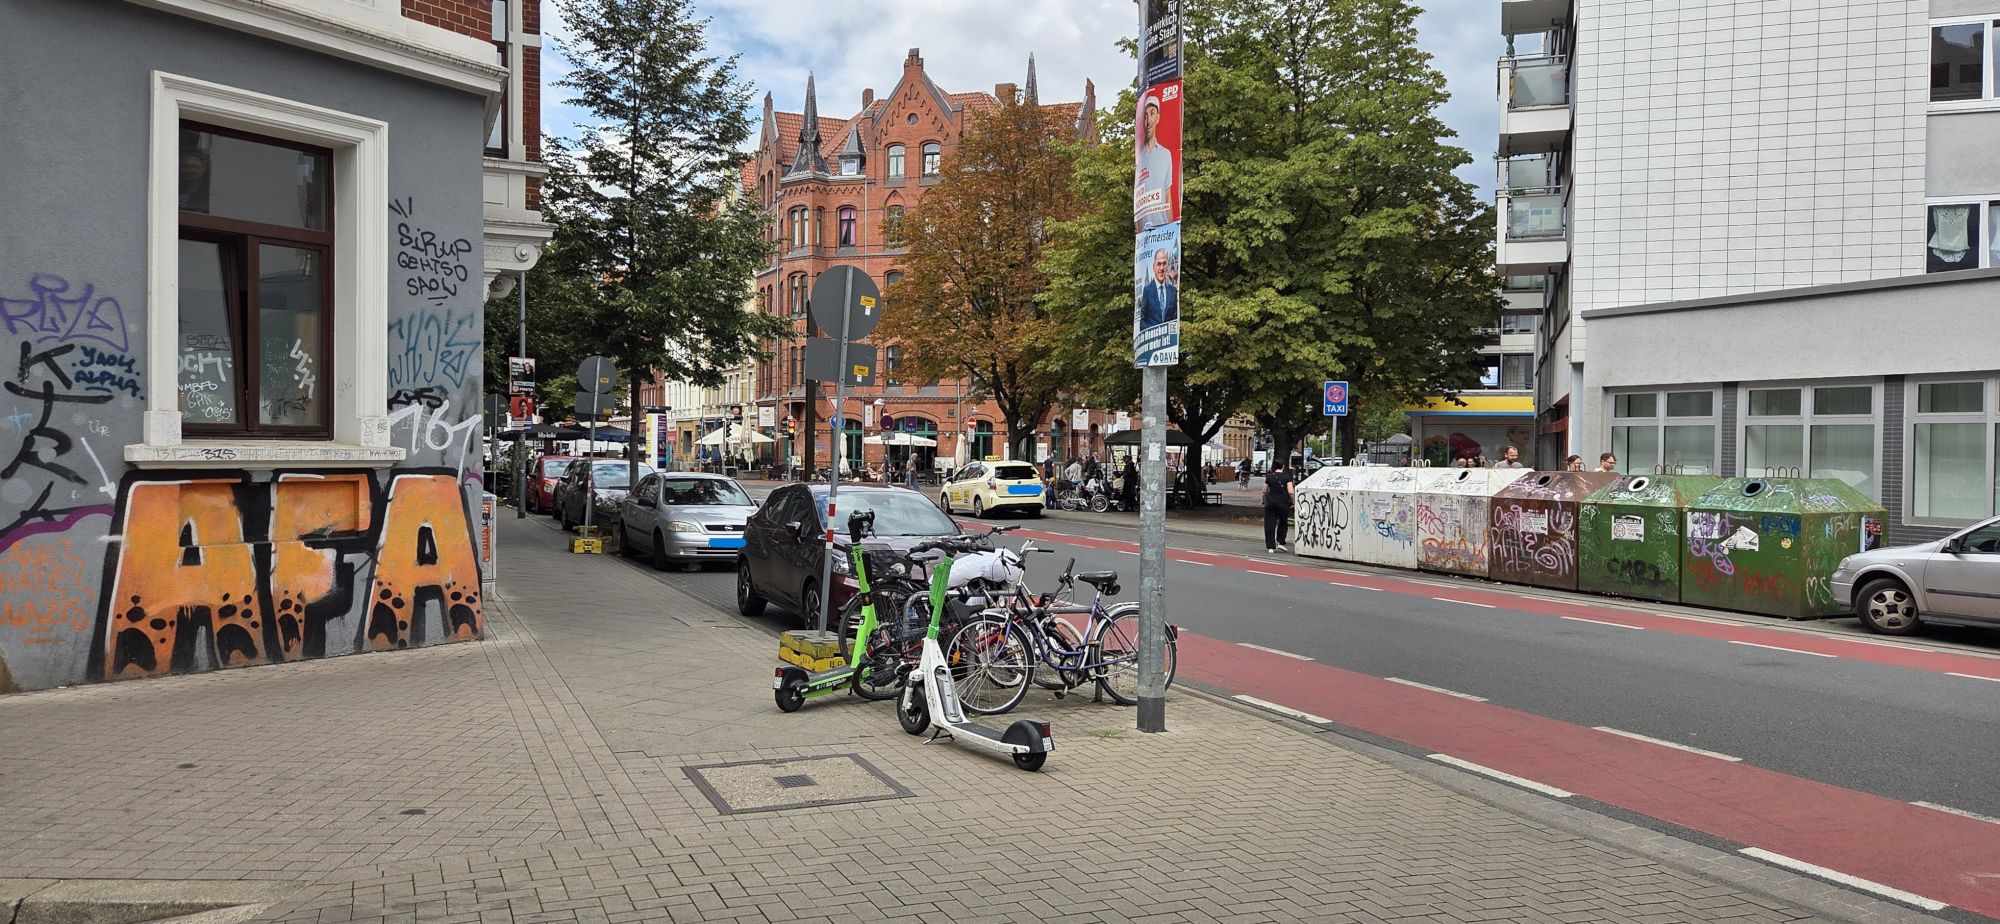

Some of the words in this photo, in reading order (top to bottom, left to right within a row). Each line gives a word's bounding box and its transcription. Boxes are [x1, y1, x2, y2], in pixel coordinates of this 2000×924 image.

[1168, 0, 1178, 13] für
[1153, 12, 1177, 34] wirklich
[1159, 25, 1177, 41] Stadt
[1162, 85, 1178, 98] SPD
[1160, 351, 1177, 362] DAVA
[1326, 404, 1345, 413] TAXI
[92, 469, 484, 681] AFA
